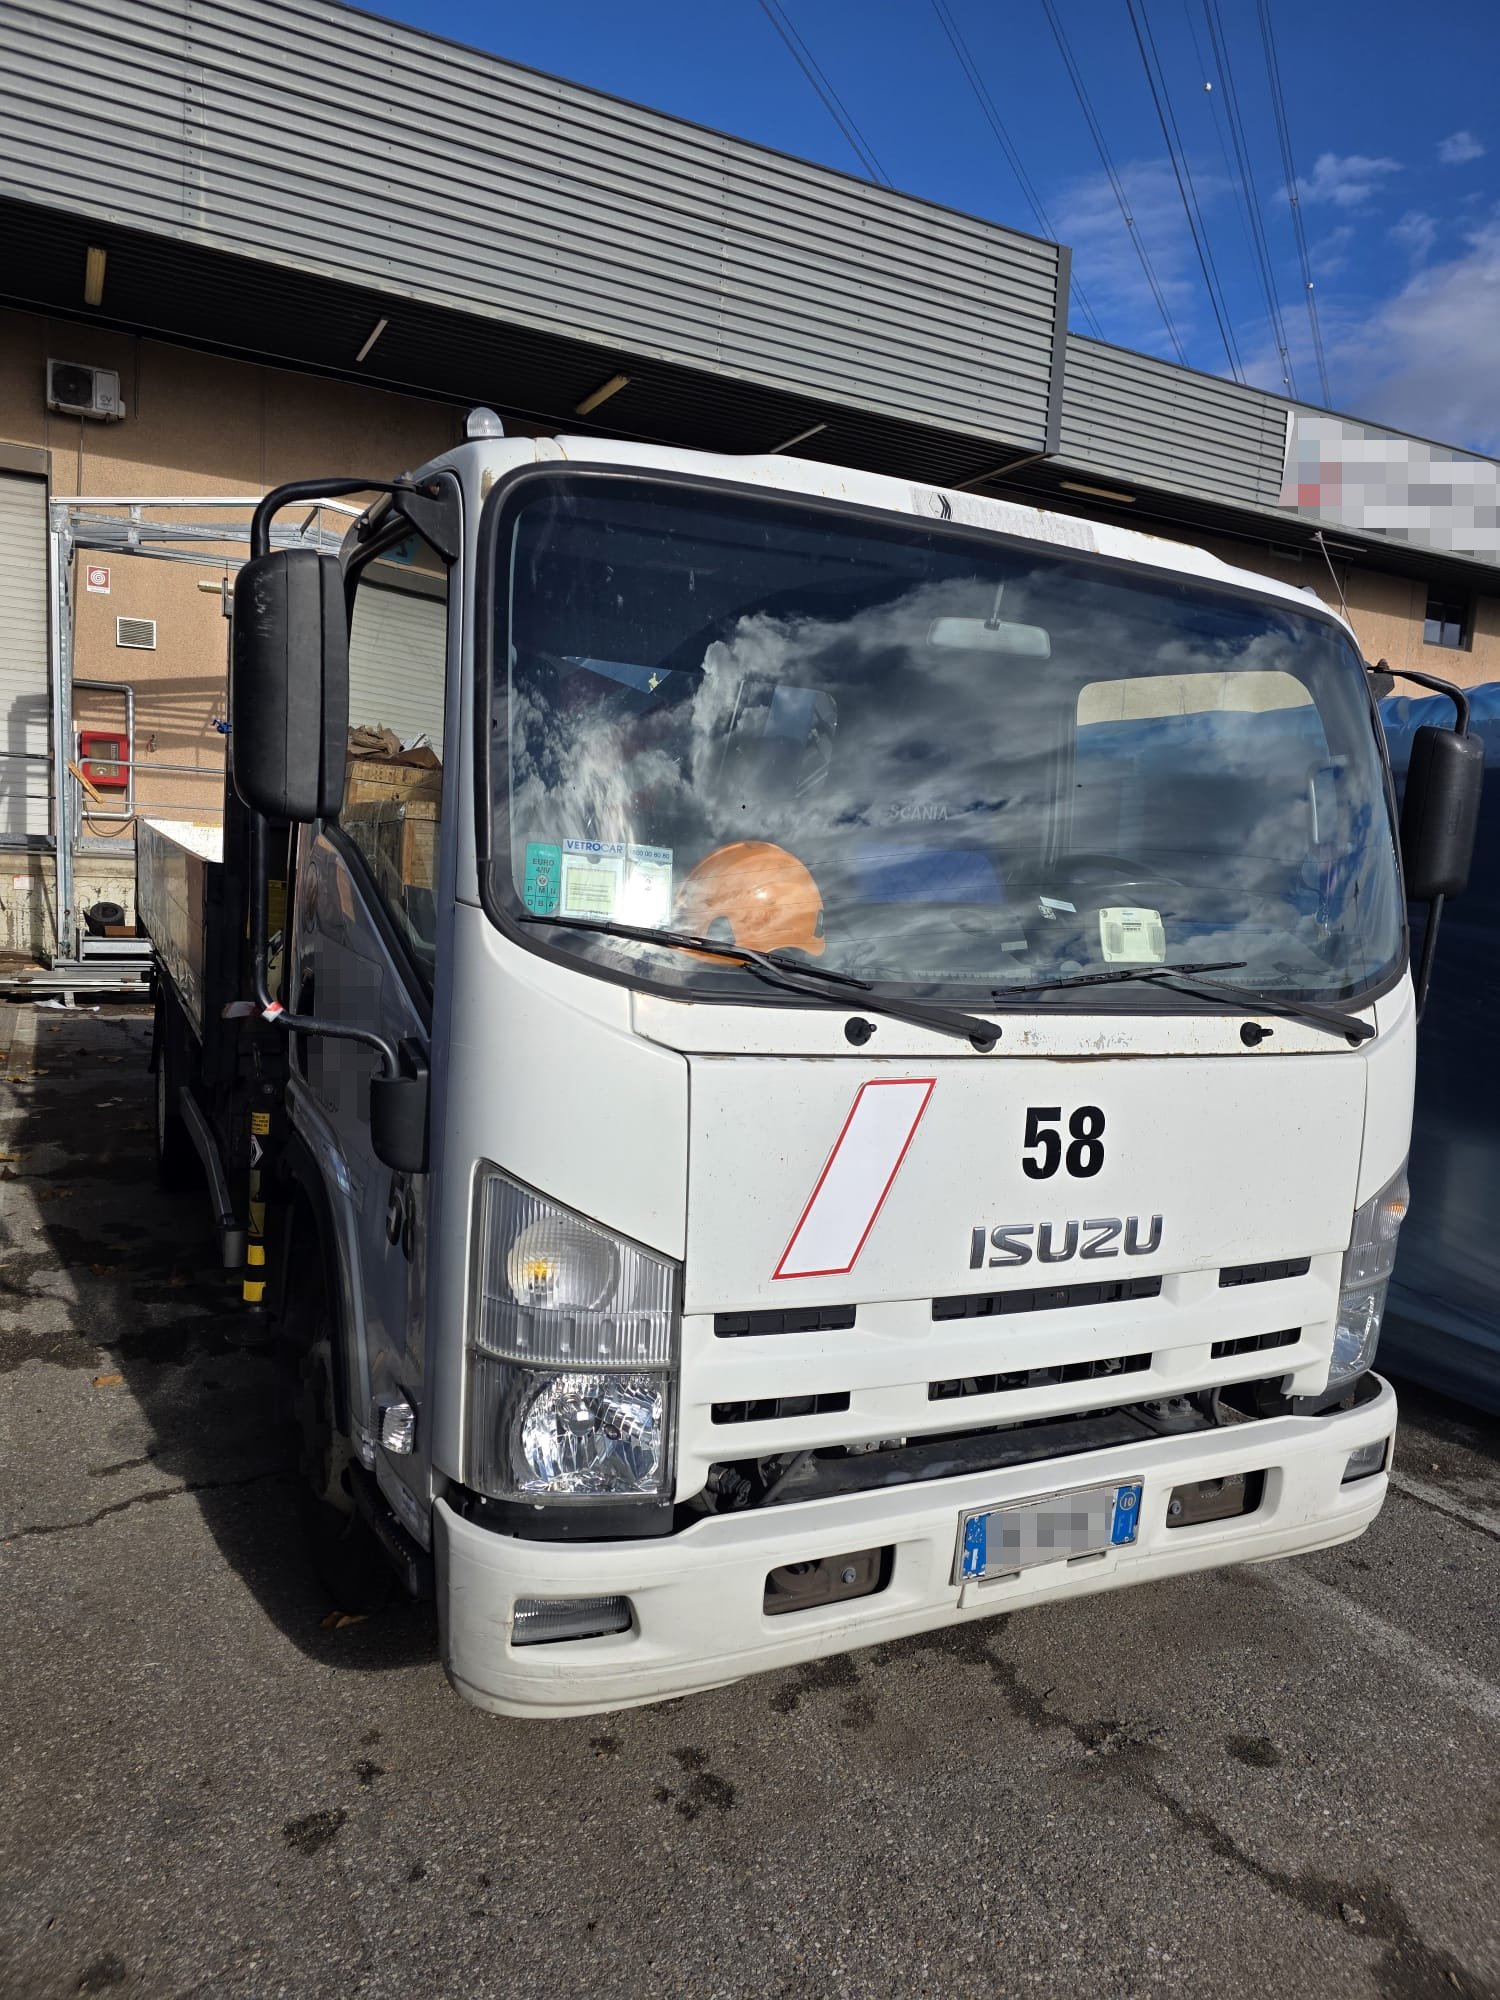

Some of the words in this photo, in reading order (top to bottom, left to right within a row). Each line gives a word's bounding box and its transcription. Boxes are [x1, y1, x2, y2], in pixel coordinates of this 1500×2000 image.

[888, 801, 949, 821] SCANIA
[532, 858, 555, 866] EURO
[567, 840, 623, 854] VETROCAR
[1022, 1105, 1106, 1180] 58
[385, 1170, 416, 1264] 58
[969, 1214, 1164, 1269] ISUZU
